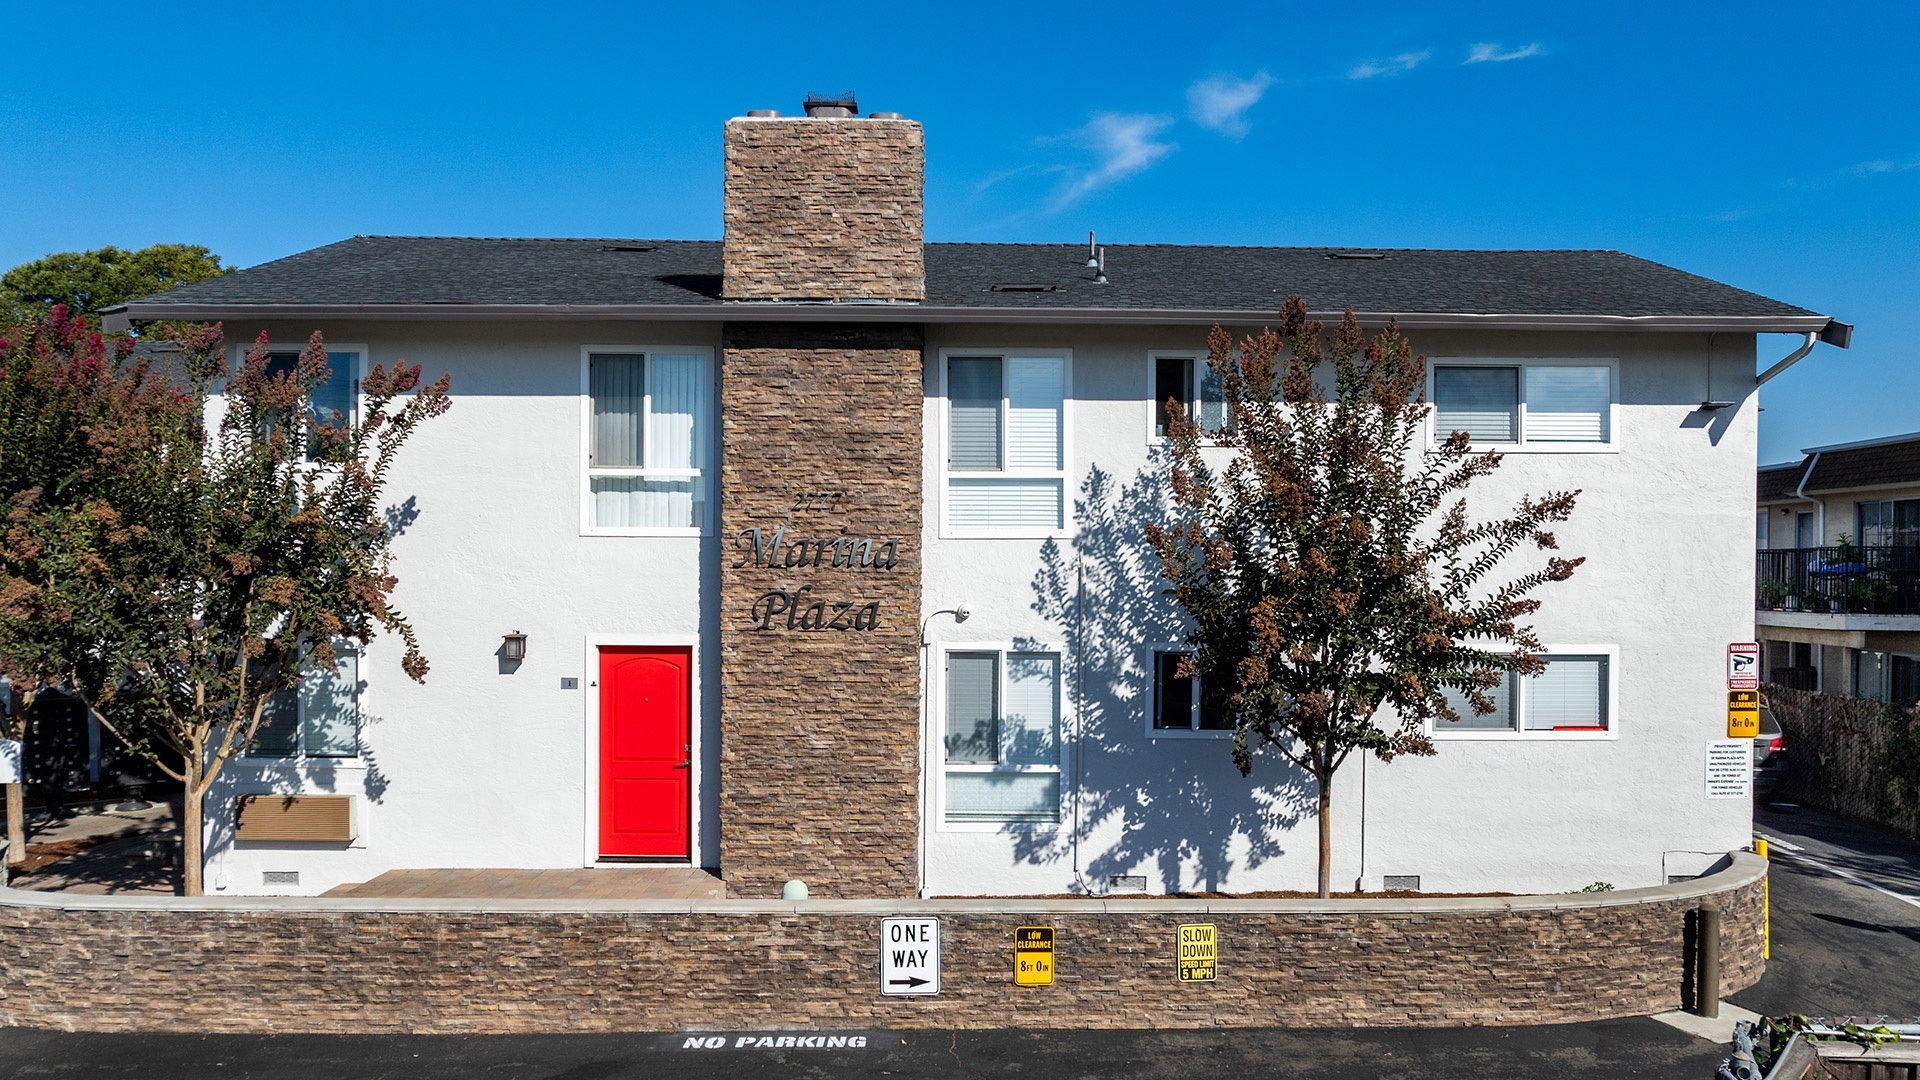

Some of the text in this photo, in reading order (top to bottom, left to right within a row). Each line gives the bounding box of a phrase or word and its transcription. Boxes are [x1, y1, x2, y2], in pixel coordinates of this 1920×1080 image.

[791, 491, 846, 512] 2777
[732, 525, 900, 570] Marina
[752, 584, 882, 631] Plaza
[891, 924, 930, 943] ONE
[1027, 931, 1042, 940] LOW
[1183, 929, 1212, 942] SLOW
[1017, 941, 1052, 949] CLEARANCE
[1182, 944, 1213, 957] DOWN
[892, 950, 928, 968] WAY
[1200, 960, 1215, 968] LIMIT
[1182, 968, 1214, 980] 5 MPH
[682, 1036, 868, 1049] NO PARKING
